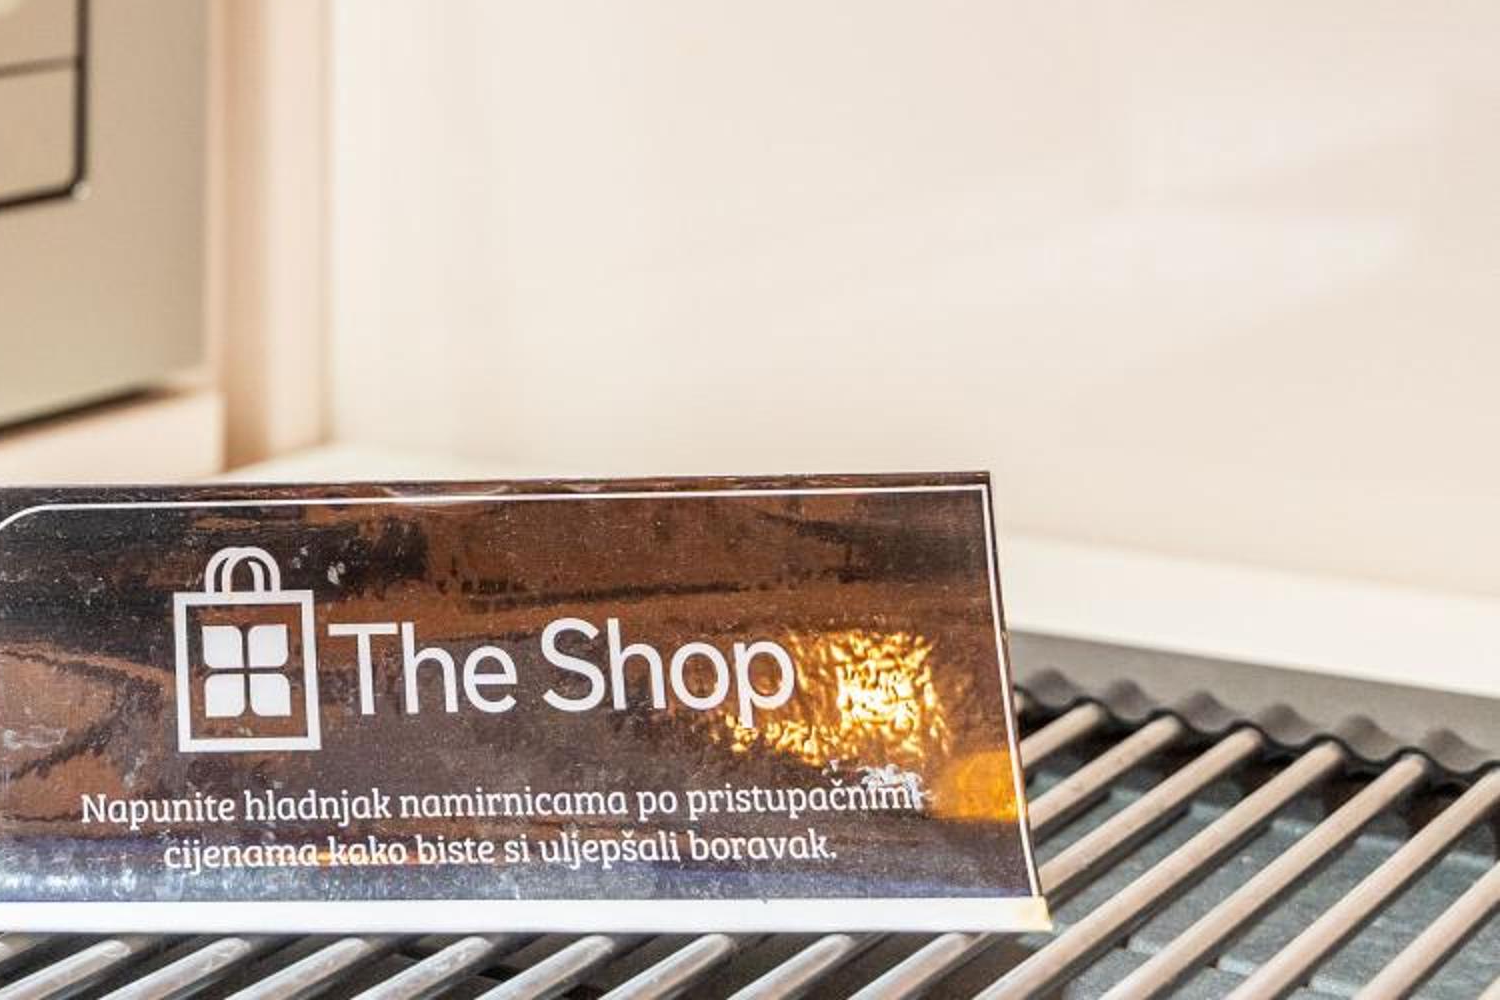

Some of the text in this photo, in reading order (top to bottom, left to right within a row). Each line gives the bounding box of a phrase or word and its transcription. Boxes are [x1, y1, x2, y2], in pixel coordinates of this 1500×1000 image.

[327, 617, 795, 728] The Shop
[81, 791, 236, 830] Napunite
[244, 789, 392, 827] hladnjak
[399, 786, 629, 819] namirnicama
[637, 789, 679, 822] po
[164, 828, 838, 875] cijenama kako biste si uljepšali boravak.
